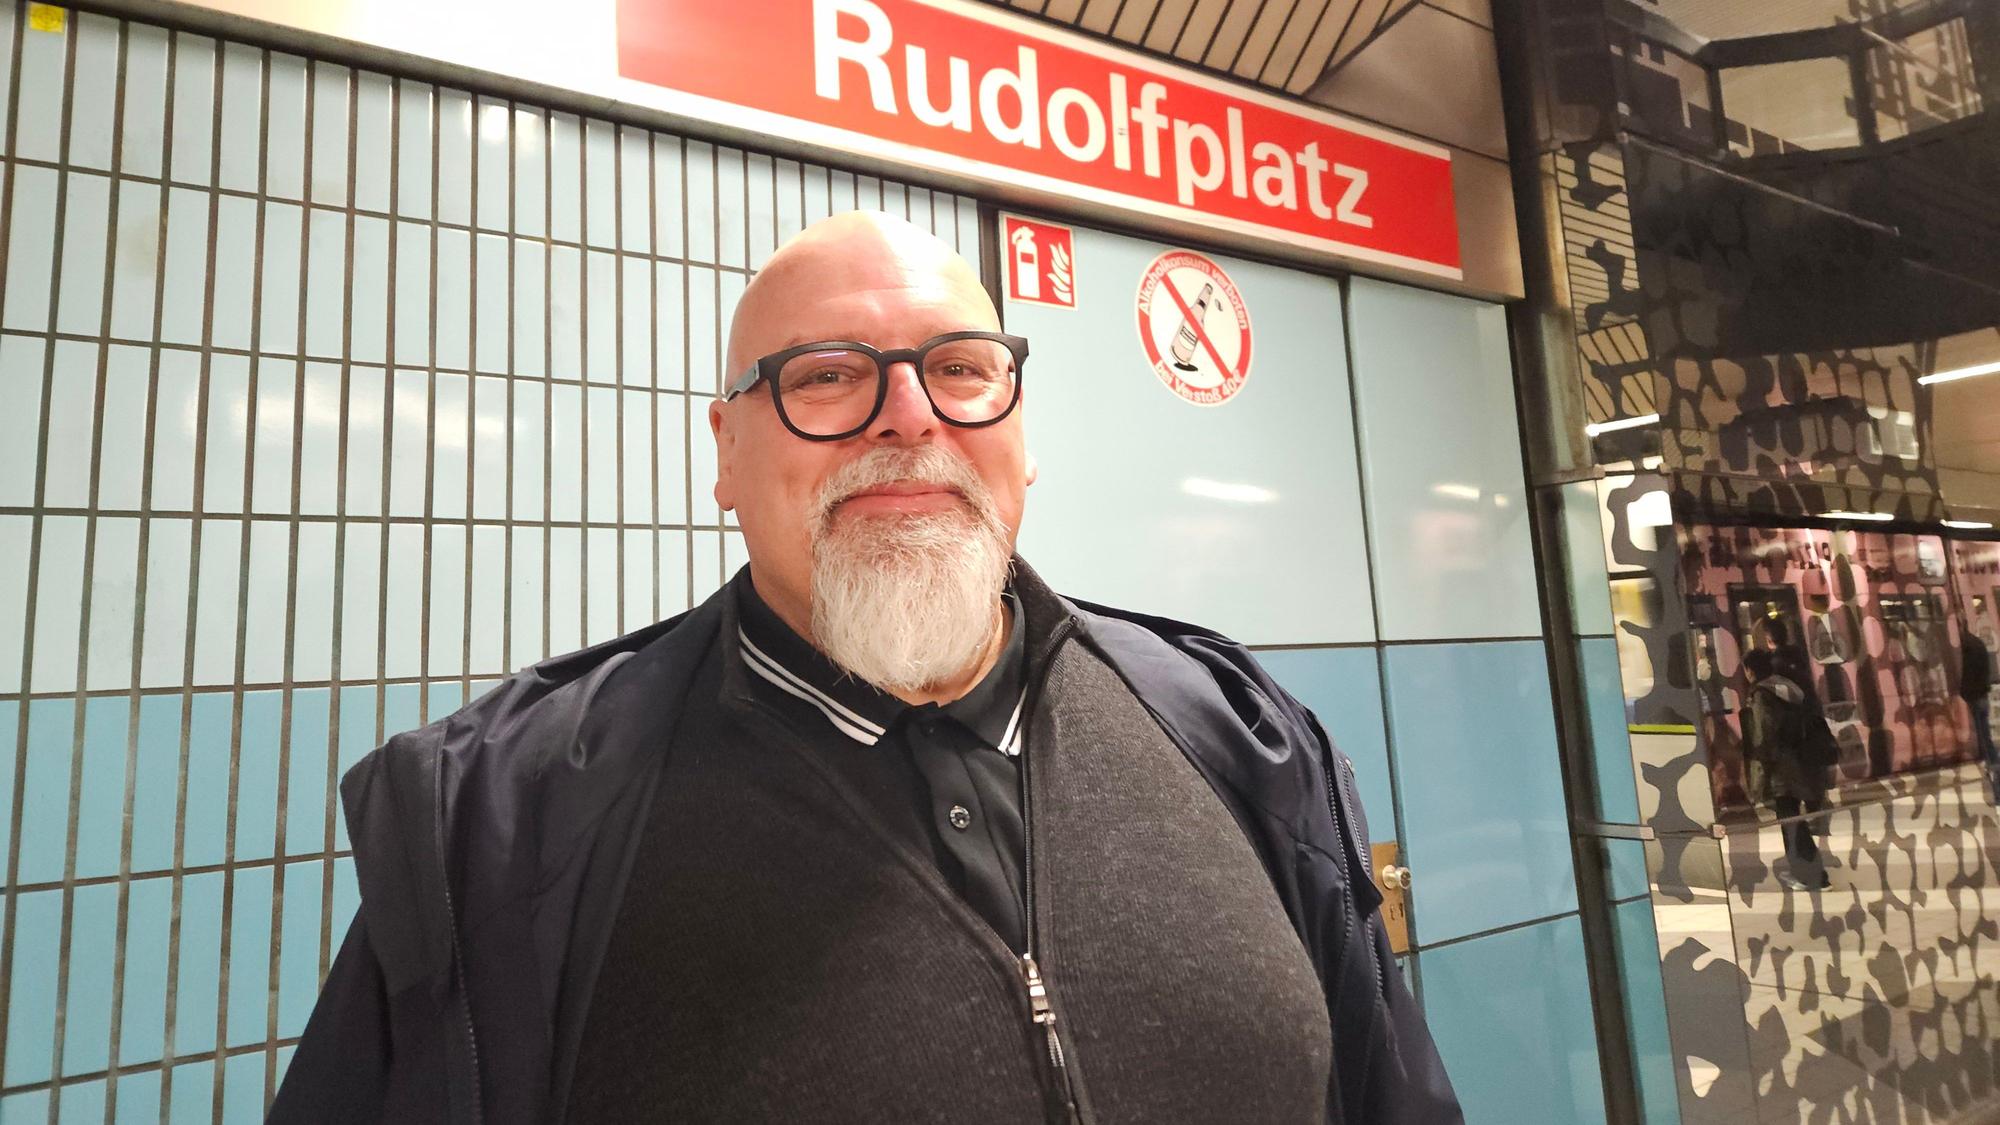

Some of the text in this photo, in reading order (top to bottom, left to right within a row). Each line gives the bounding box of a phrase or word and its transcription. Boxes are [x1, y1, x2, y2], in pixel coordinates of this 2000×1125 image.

[813, 0, 1373, 229] Rudolfplatz
[1139, 256, 1249, 330] Alkoholkonsum verboten
[1155, 359, 1174, 385] bei
[1174, 378, 1222, 403] Verstoß
